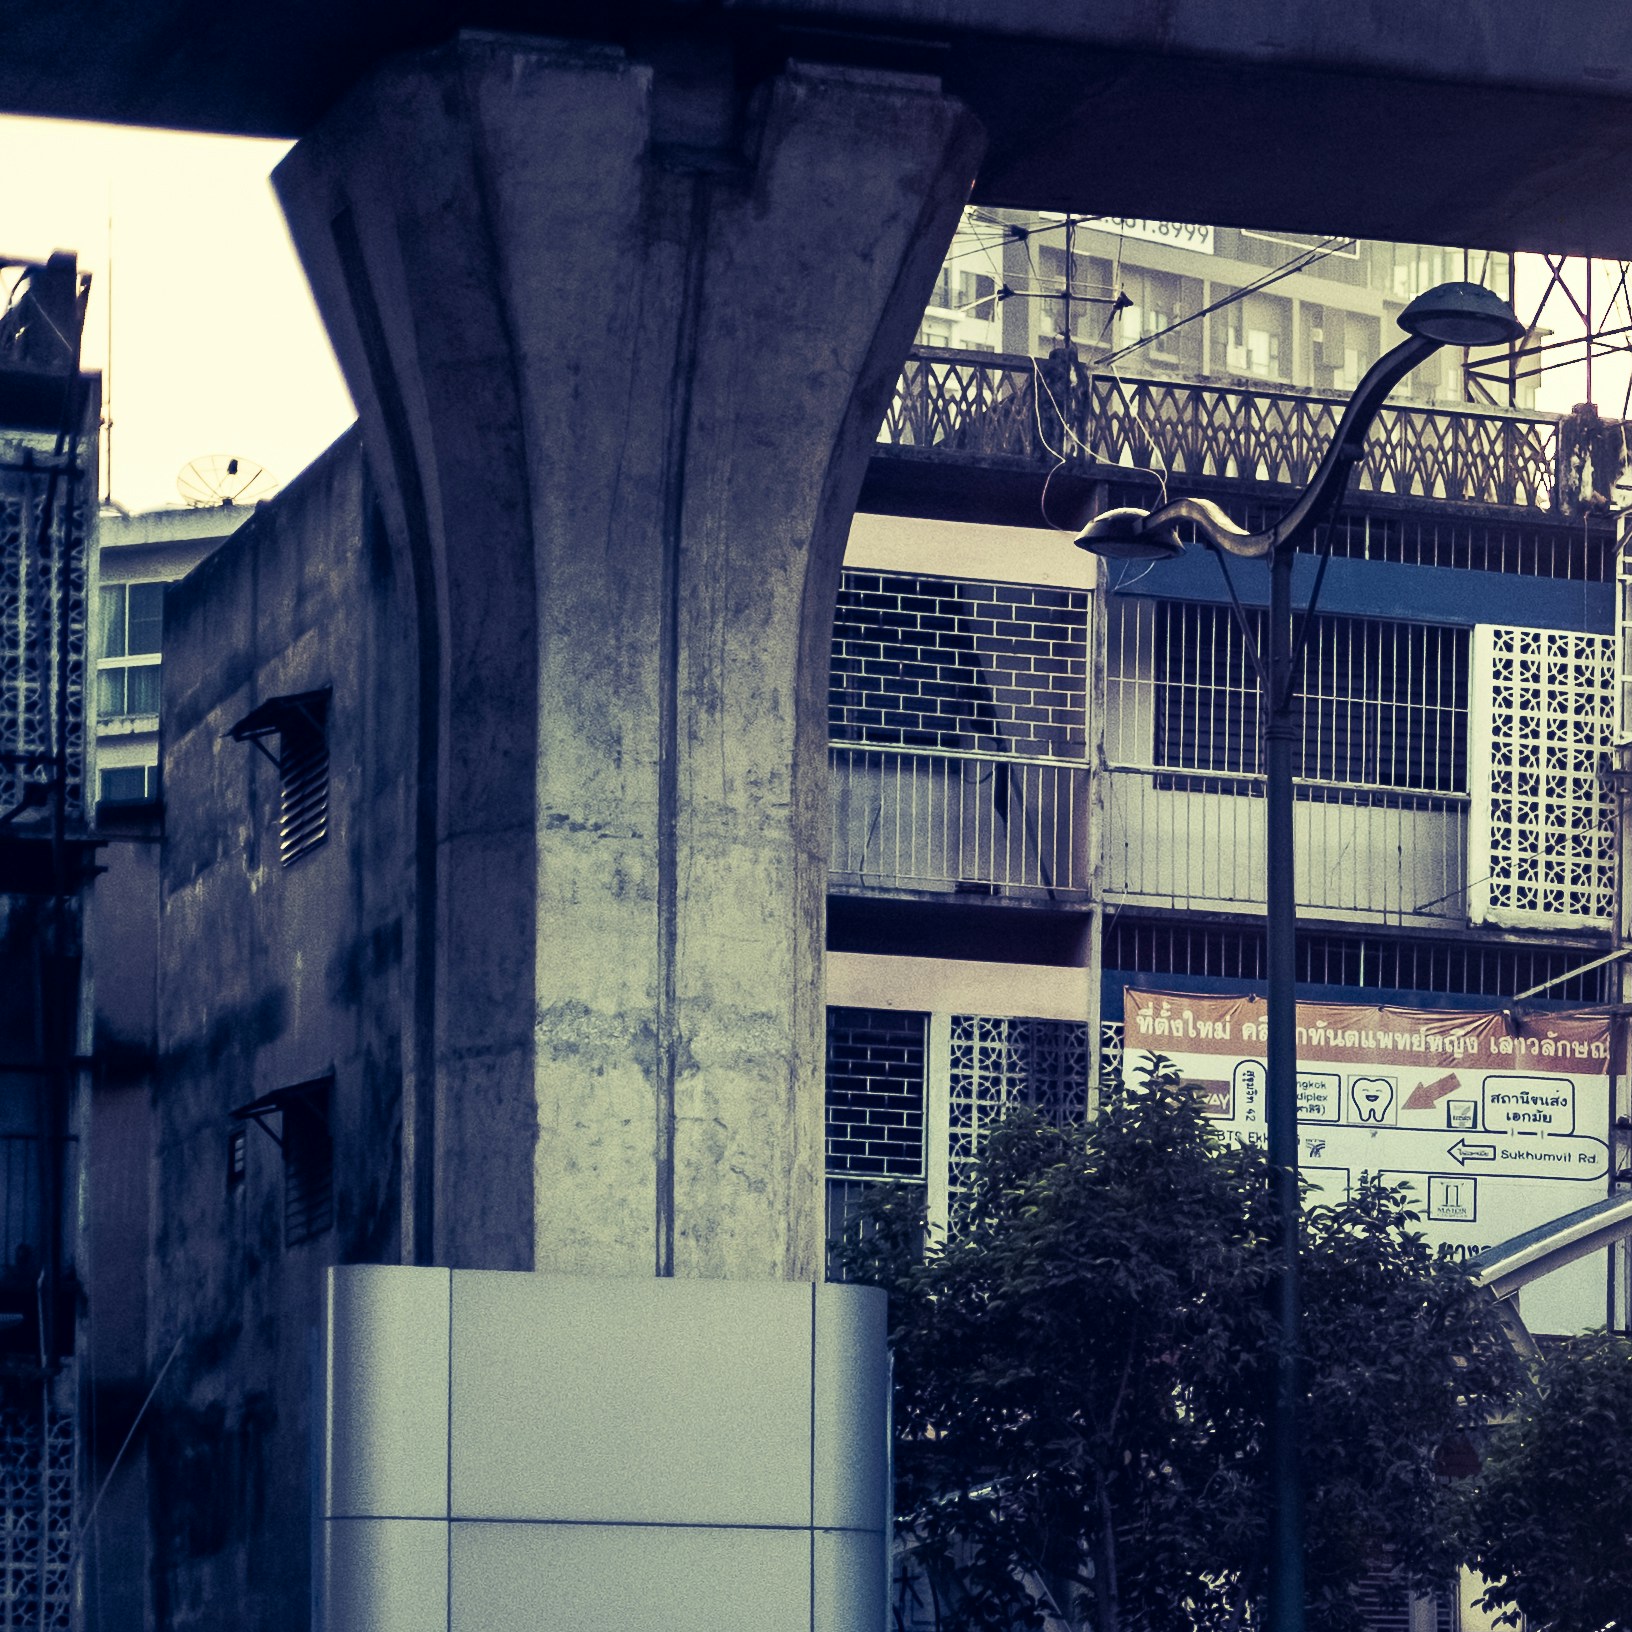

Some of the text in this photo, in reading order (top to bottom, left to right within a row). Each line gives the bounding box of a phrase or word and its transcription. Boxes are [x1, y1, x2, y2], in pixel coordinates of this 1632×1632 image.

[1136, 1001, 1232, 1040] ที่ตั้งใหม่
[1500, 1149, 1572, 1163] Sukhumvit
